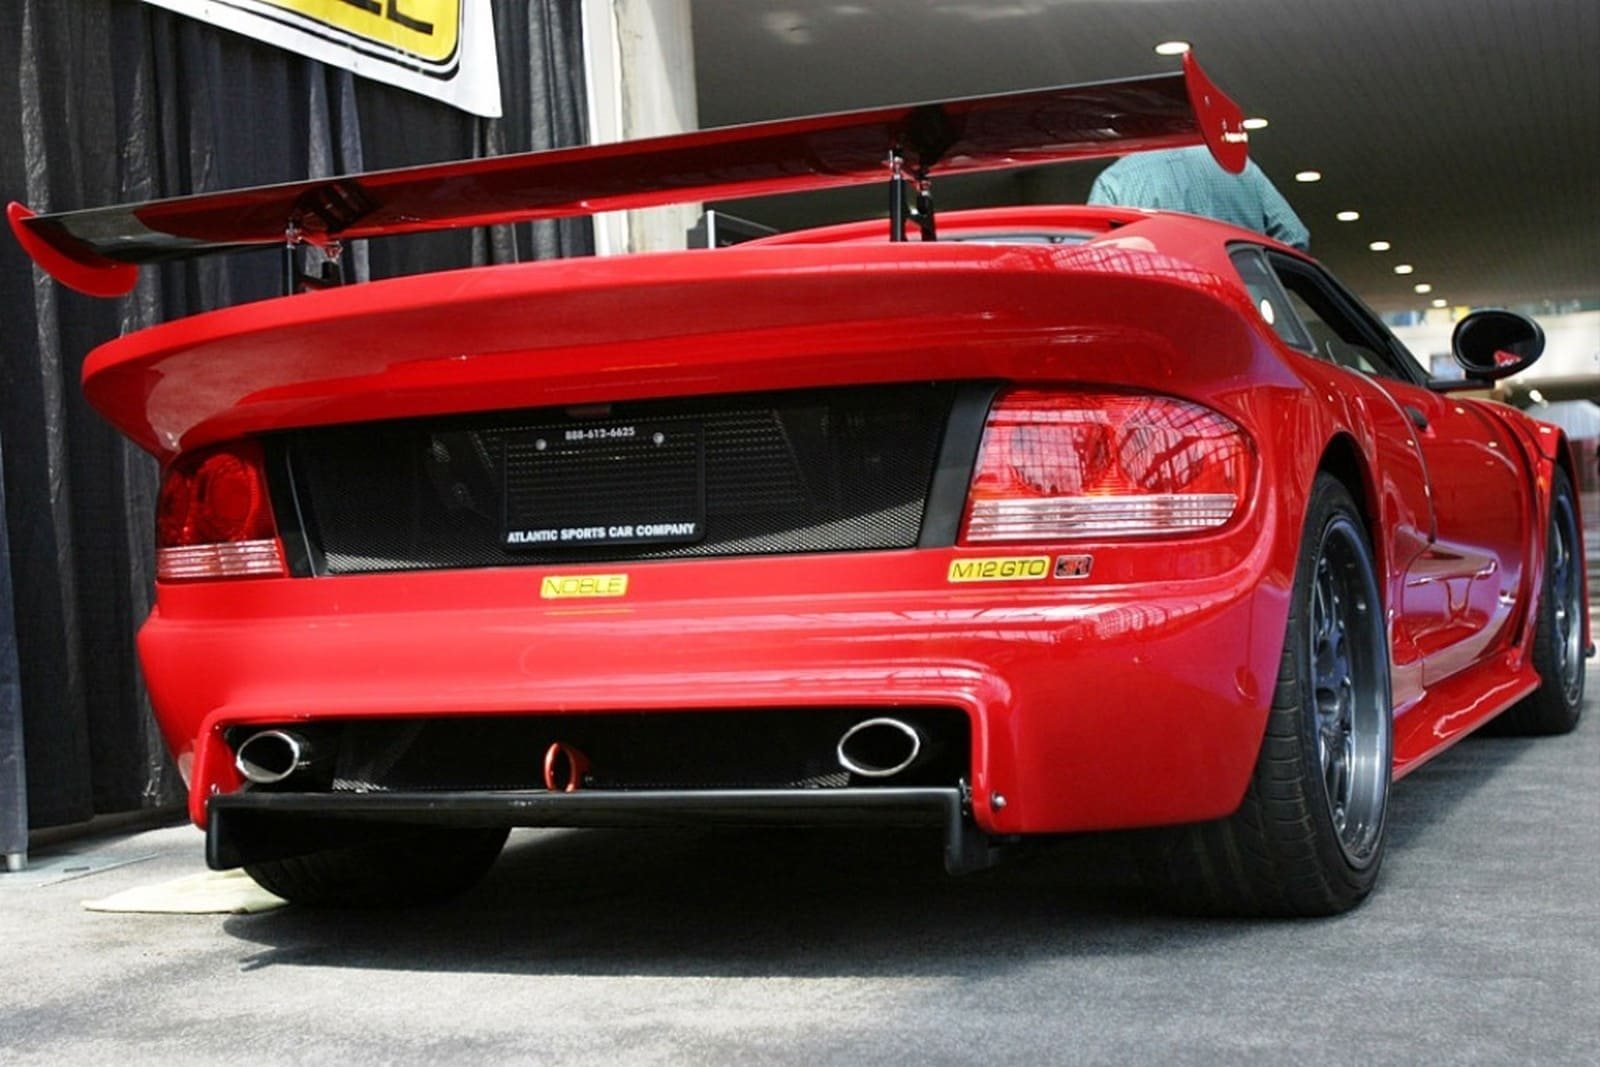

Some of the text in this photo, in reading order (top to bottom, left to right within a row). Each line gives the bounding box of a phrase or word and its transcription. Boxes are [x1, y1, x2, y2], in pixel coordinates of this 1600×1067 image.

[565, 426, 636, 440] 888-612-6625
[507, 522, 696, 543] ATLANTIC SPORTS CAR COMPANY
[951, 562, 997, 578] M12
[1000, 559, 1047, 577] GTO
[544, 577, 624, 595] NOBLE
